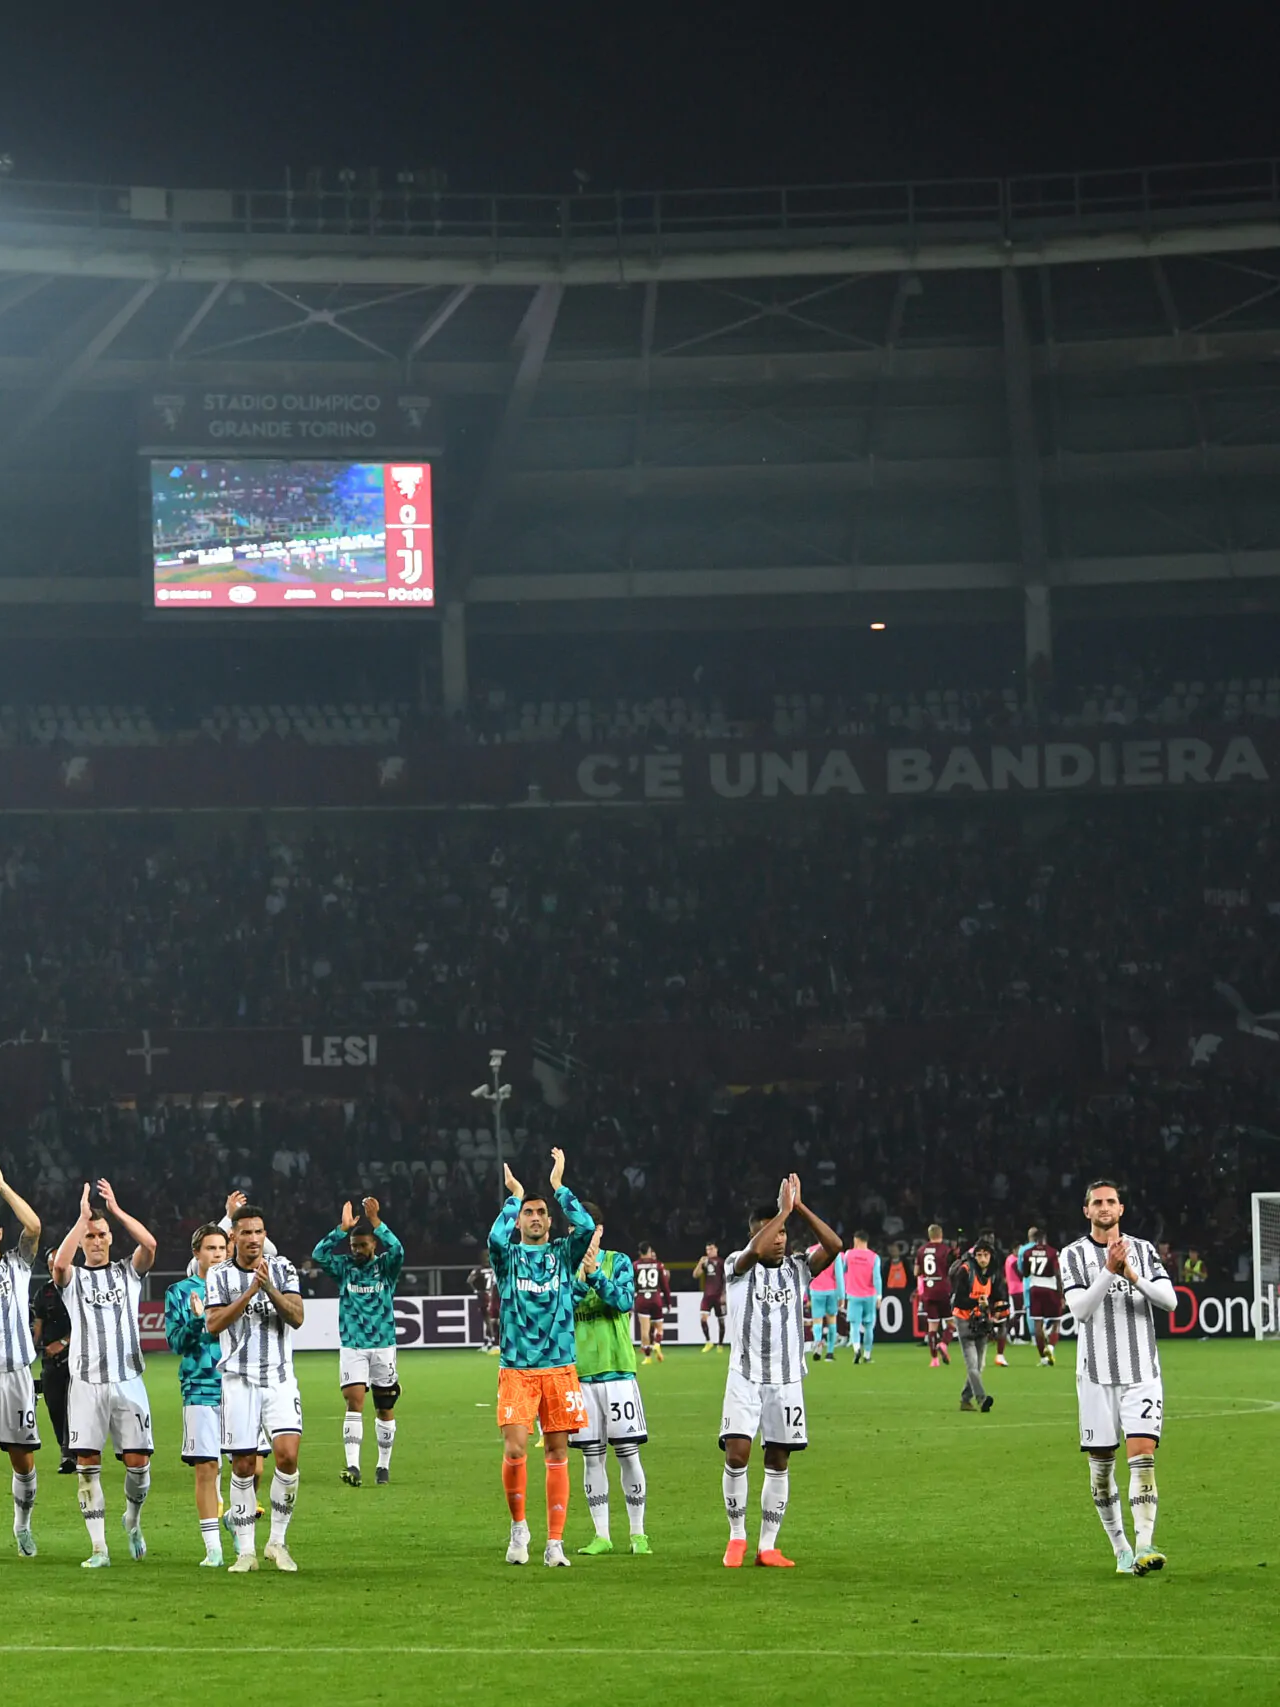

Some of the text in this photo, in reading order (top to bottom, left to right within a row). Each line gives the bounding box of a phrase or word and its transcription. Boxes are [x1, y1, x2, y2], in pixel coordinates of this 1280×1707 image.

[204, 394, 381, 411] STADIO OLIMPICO
[209, 420, 376, 438] GRANDE TORINO
[399, 504, 416, 524] 0
[401, 529, 414, 549] 1
[577, 737, 1269, 797] C'È UNA BANDIERA
[923, 1254, 937, 1276] 6
[1028, 1256, 1048, 1276] 17
[347, 1282, 375, 1293] Allianz
[637, 1268, 659, 1288] 49
[84, 1288, 124, 1306] Jeep
[755, 1285, 794, 1304] Jeep
[245, 1301, 277, 1316] eep
[610, 1400, 635, 1422] 30
[784, 1406, 804, 1427] 12
[1140, 1398, 1162, 1420] 25
[17, 1410, 36, 1429] 19
[135, 1413, 150, 1432] 14
